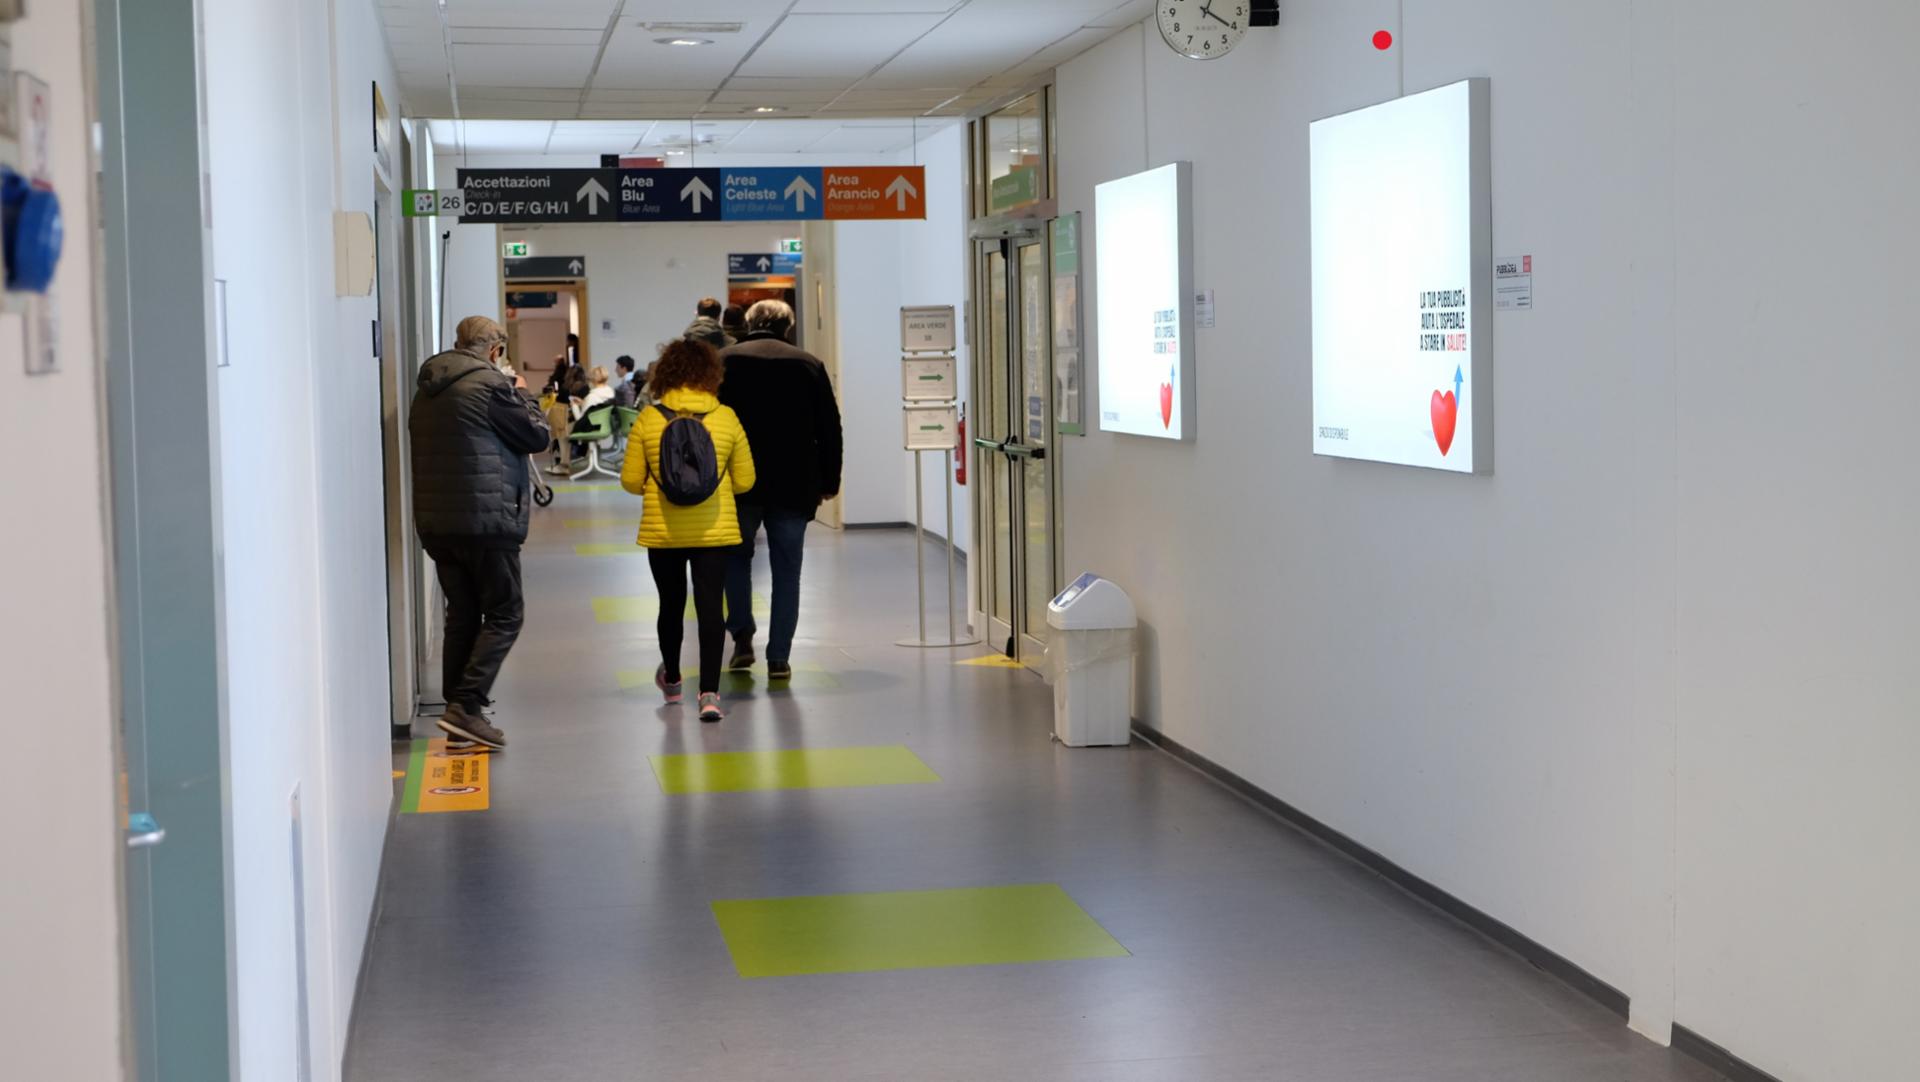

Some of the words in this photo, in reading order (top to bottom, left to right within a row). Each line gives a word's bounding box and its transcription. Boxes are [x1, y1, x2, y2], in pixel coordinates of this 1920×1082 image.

[1169, 7, 1176, 17] 9
[1236, 7, 1243, 16] 3
[1174, 23, 1180, 32] 8
[1230, 21, 1237, 30] 4
[1187, 35, 1193, 45] 7
[1221, 34, 1228, 44] 5
[1203, 41, 1210, 50] 6
[464, 176, 550, 188] Accettazioni
[621, 175, 654, 187] Area
[725, 174, 757, 186] Area
[827, 174, 859, 185] Area
[621, 189, 645, 202] Blu
[725, 188, 777, 200] Celeste
[828, 187, 880, 199] Arancio
[442, 197, 460, 209] 26
[465, 201, 569, 215] C/D/E/F/G/H/I
[1420, 291, 1426, 309] LA
[1427, 291, 1436, 308] TUA
[1421, 313, 1435, 329] AIUTA
[1420, 334, 1424, 351] A
[1424, 334, 1439, 351] STARE
[1440, 334, 1446, 351] IN
